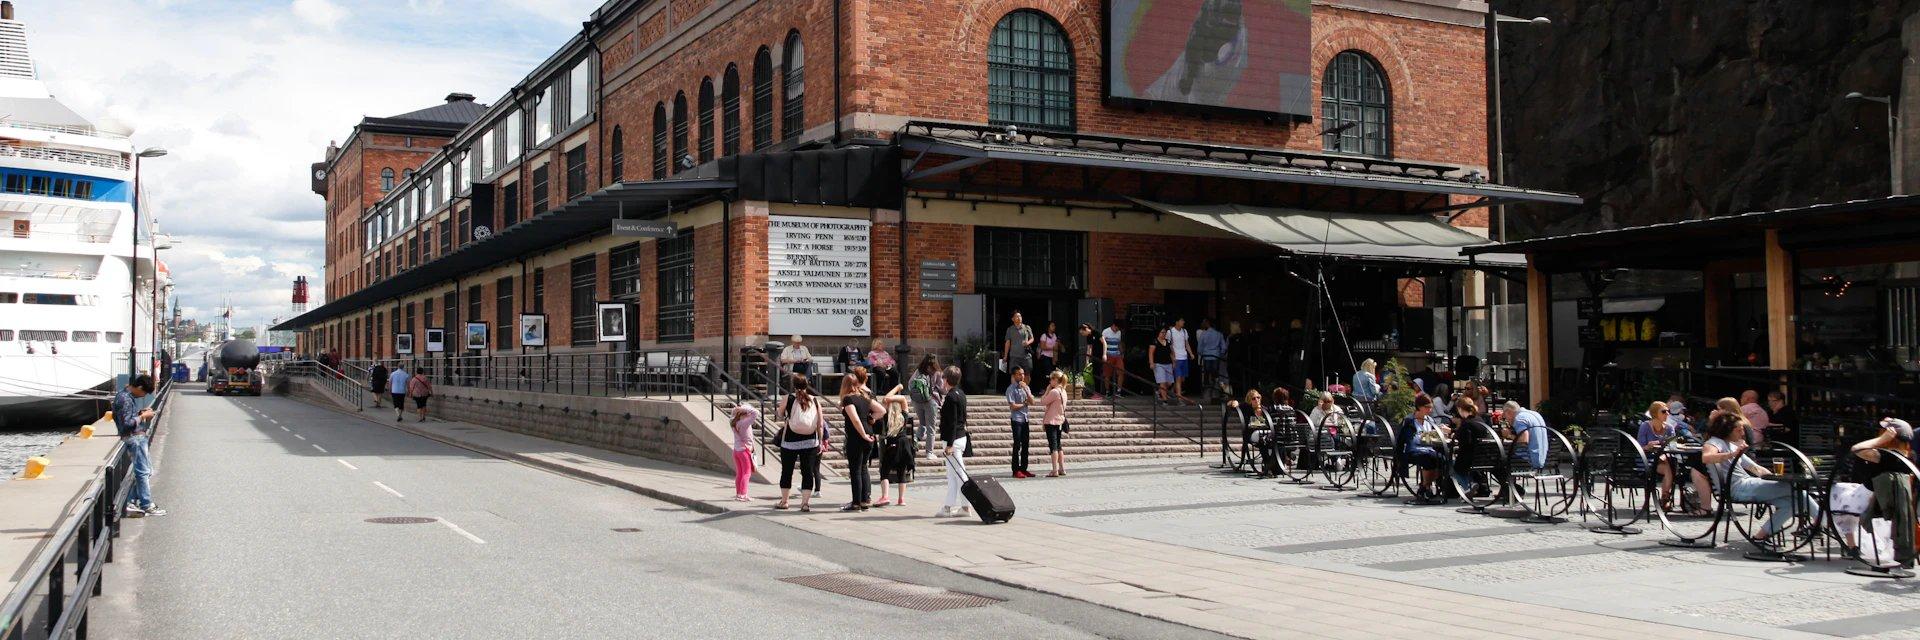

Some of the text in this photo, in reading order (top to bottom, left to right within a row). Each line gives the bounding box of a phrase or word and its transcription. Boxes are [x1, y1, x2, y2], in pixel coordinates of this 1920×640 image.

[767, 220, 780, 228] THE
[781, 221, 809, 229] MUSEUM
[820, 222, 868, 231] PHOTOGRAPHY
[1069, 276, 1079, 289] A
